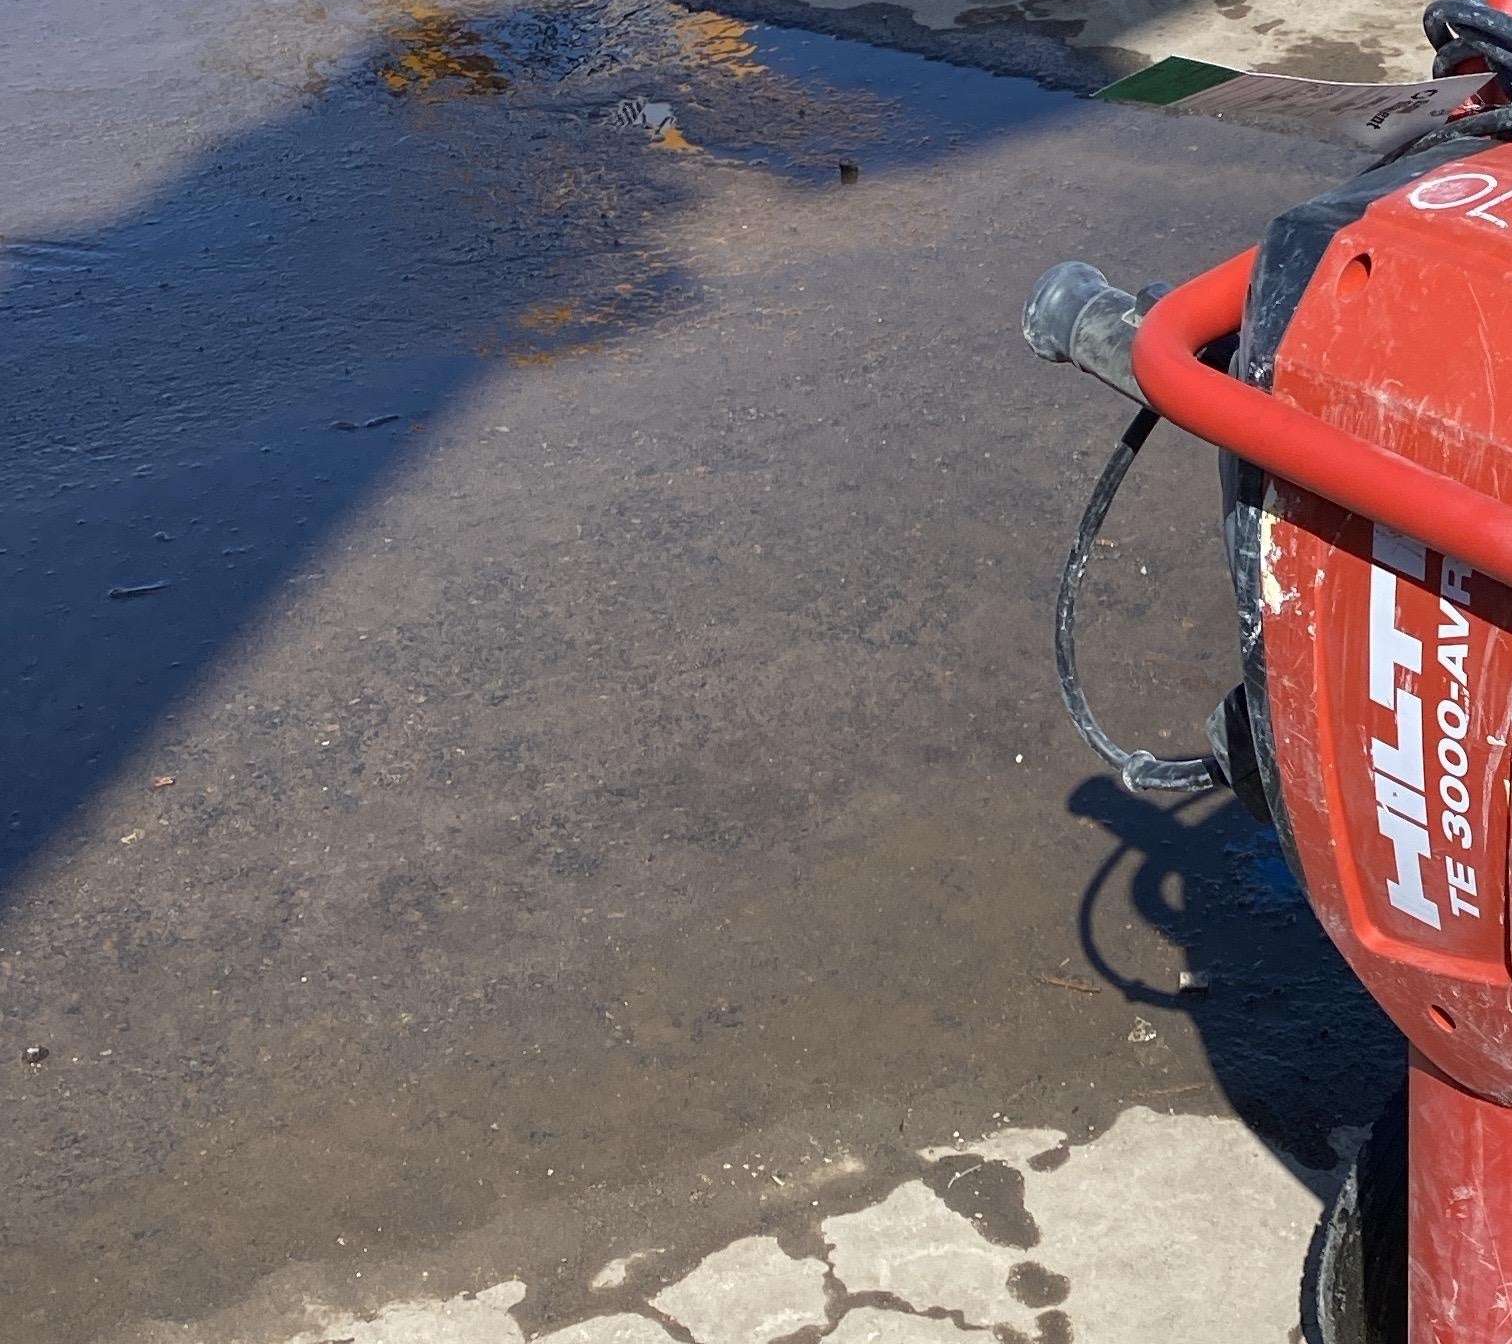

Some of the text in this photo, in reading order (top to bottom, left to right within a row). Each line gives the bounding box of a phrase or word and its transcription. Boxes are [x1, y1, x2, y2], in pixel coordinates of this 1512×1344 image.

[1369, 521, 1441, 931] HILTI
[1437, 555, 1481, 918] TE 3000-AVR
